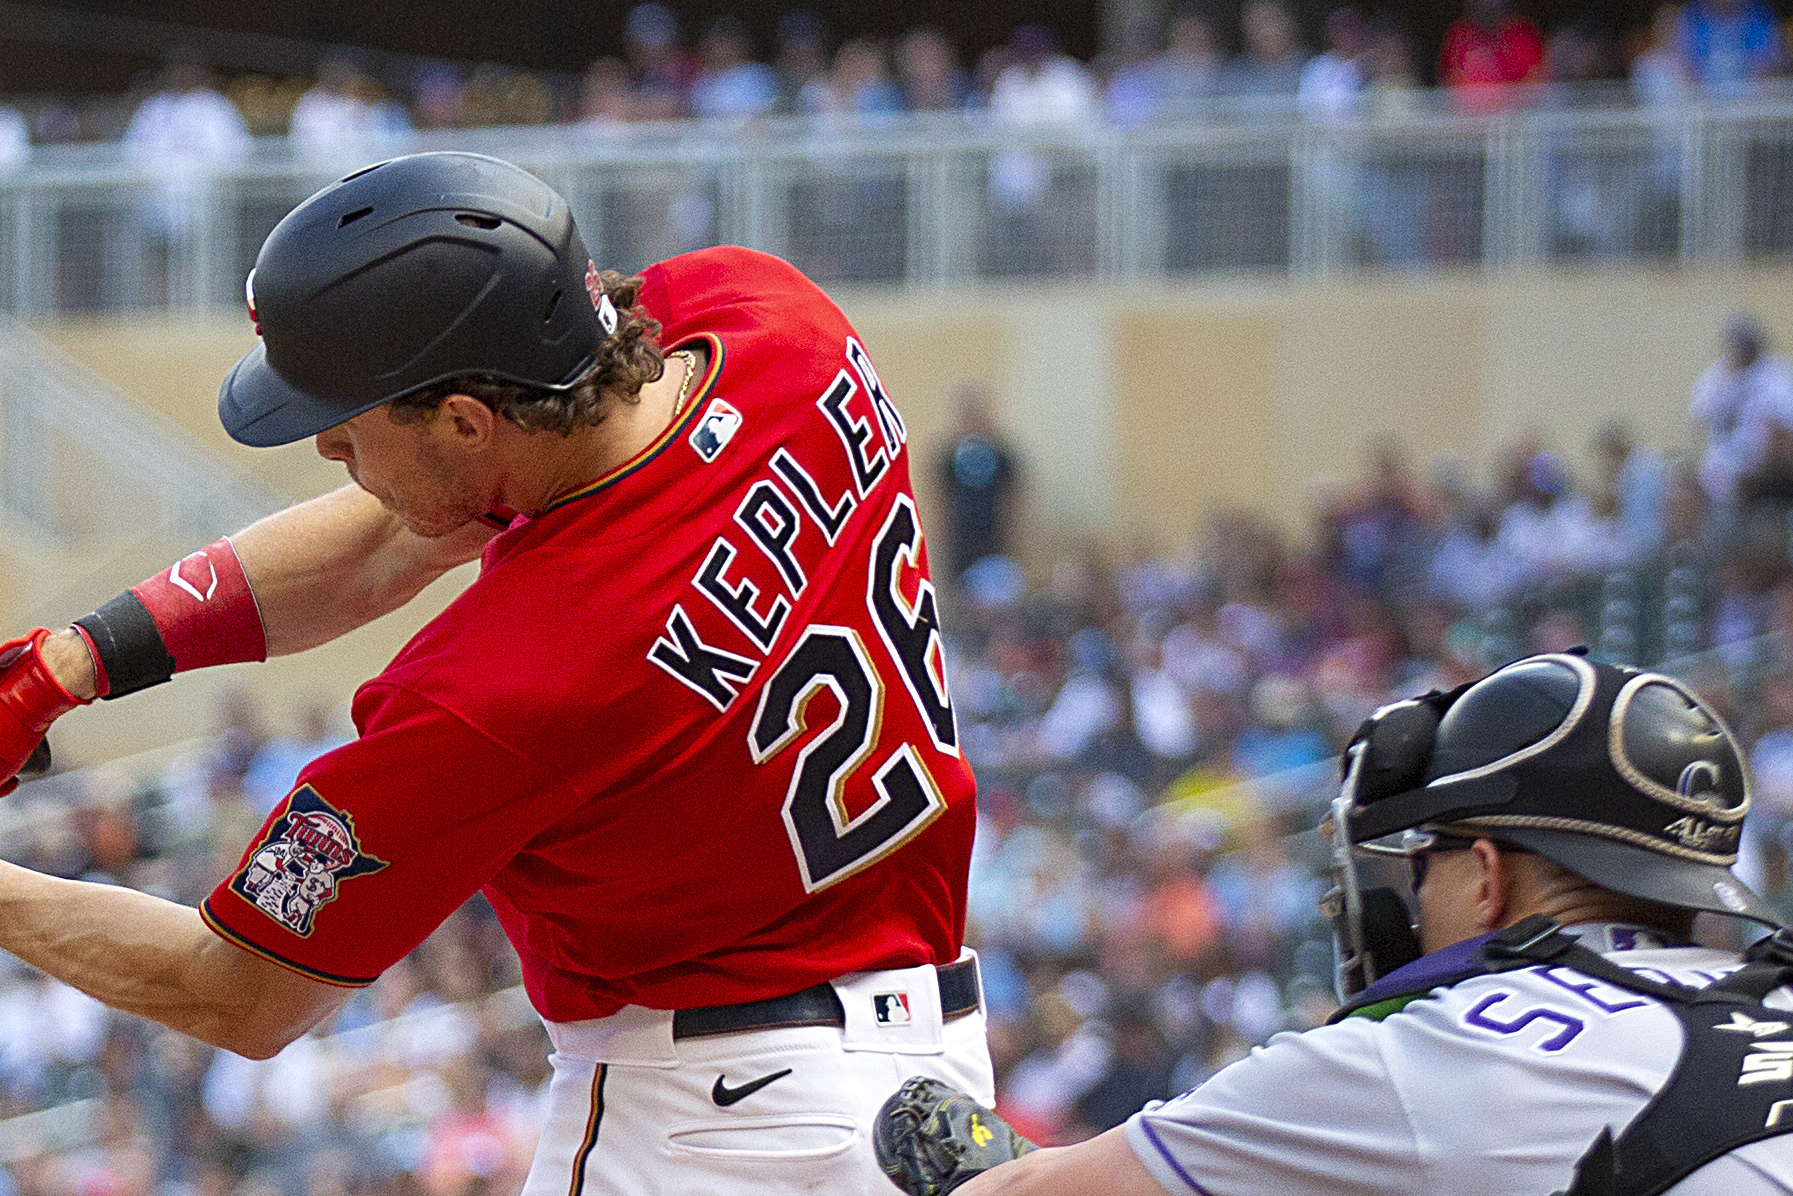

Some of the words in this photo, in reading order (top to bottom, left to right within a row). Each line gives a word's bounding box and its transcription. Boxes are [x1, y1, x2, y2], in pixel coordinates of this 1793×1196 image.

[647, 336, 908, 713] KEPLER
[747, 493, 960, 894] 26
[280, 811, 358, 867] Twins
